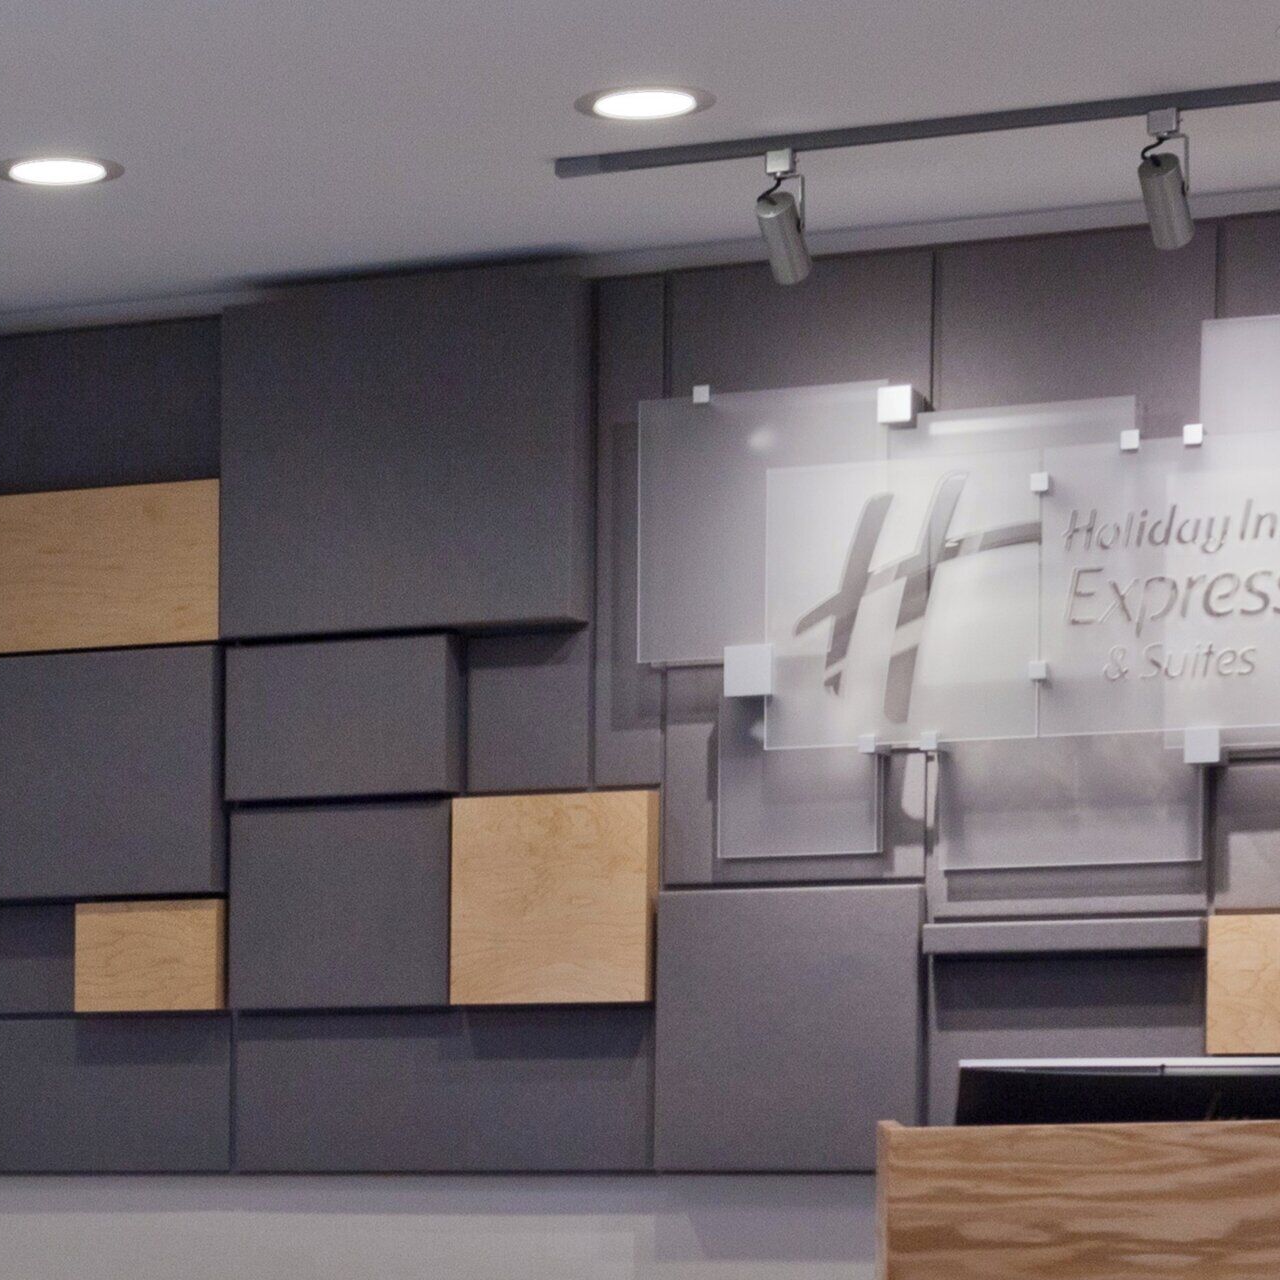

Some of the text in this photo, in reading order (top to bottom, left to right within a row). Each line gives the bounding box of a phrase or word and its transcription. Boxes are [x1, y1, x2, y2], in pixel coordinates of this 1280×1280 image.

[1063, 503, 1232, 555] Holiday
[1102, 642, 1257, 682] & Suites
